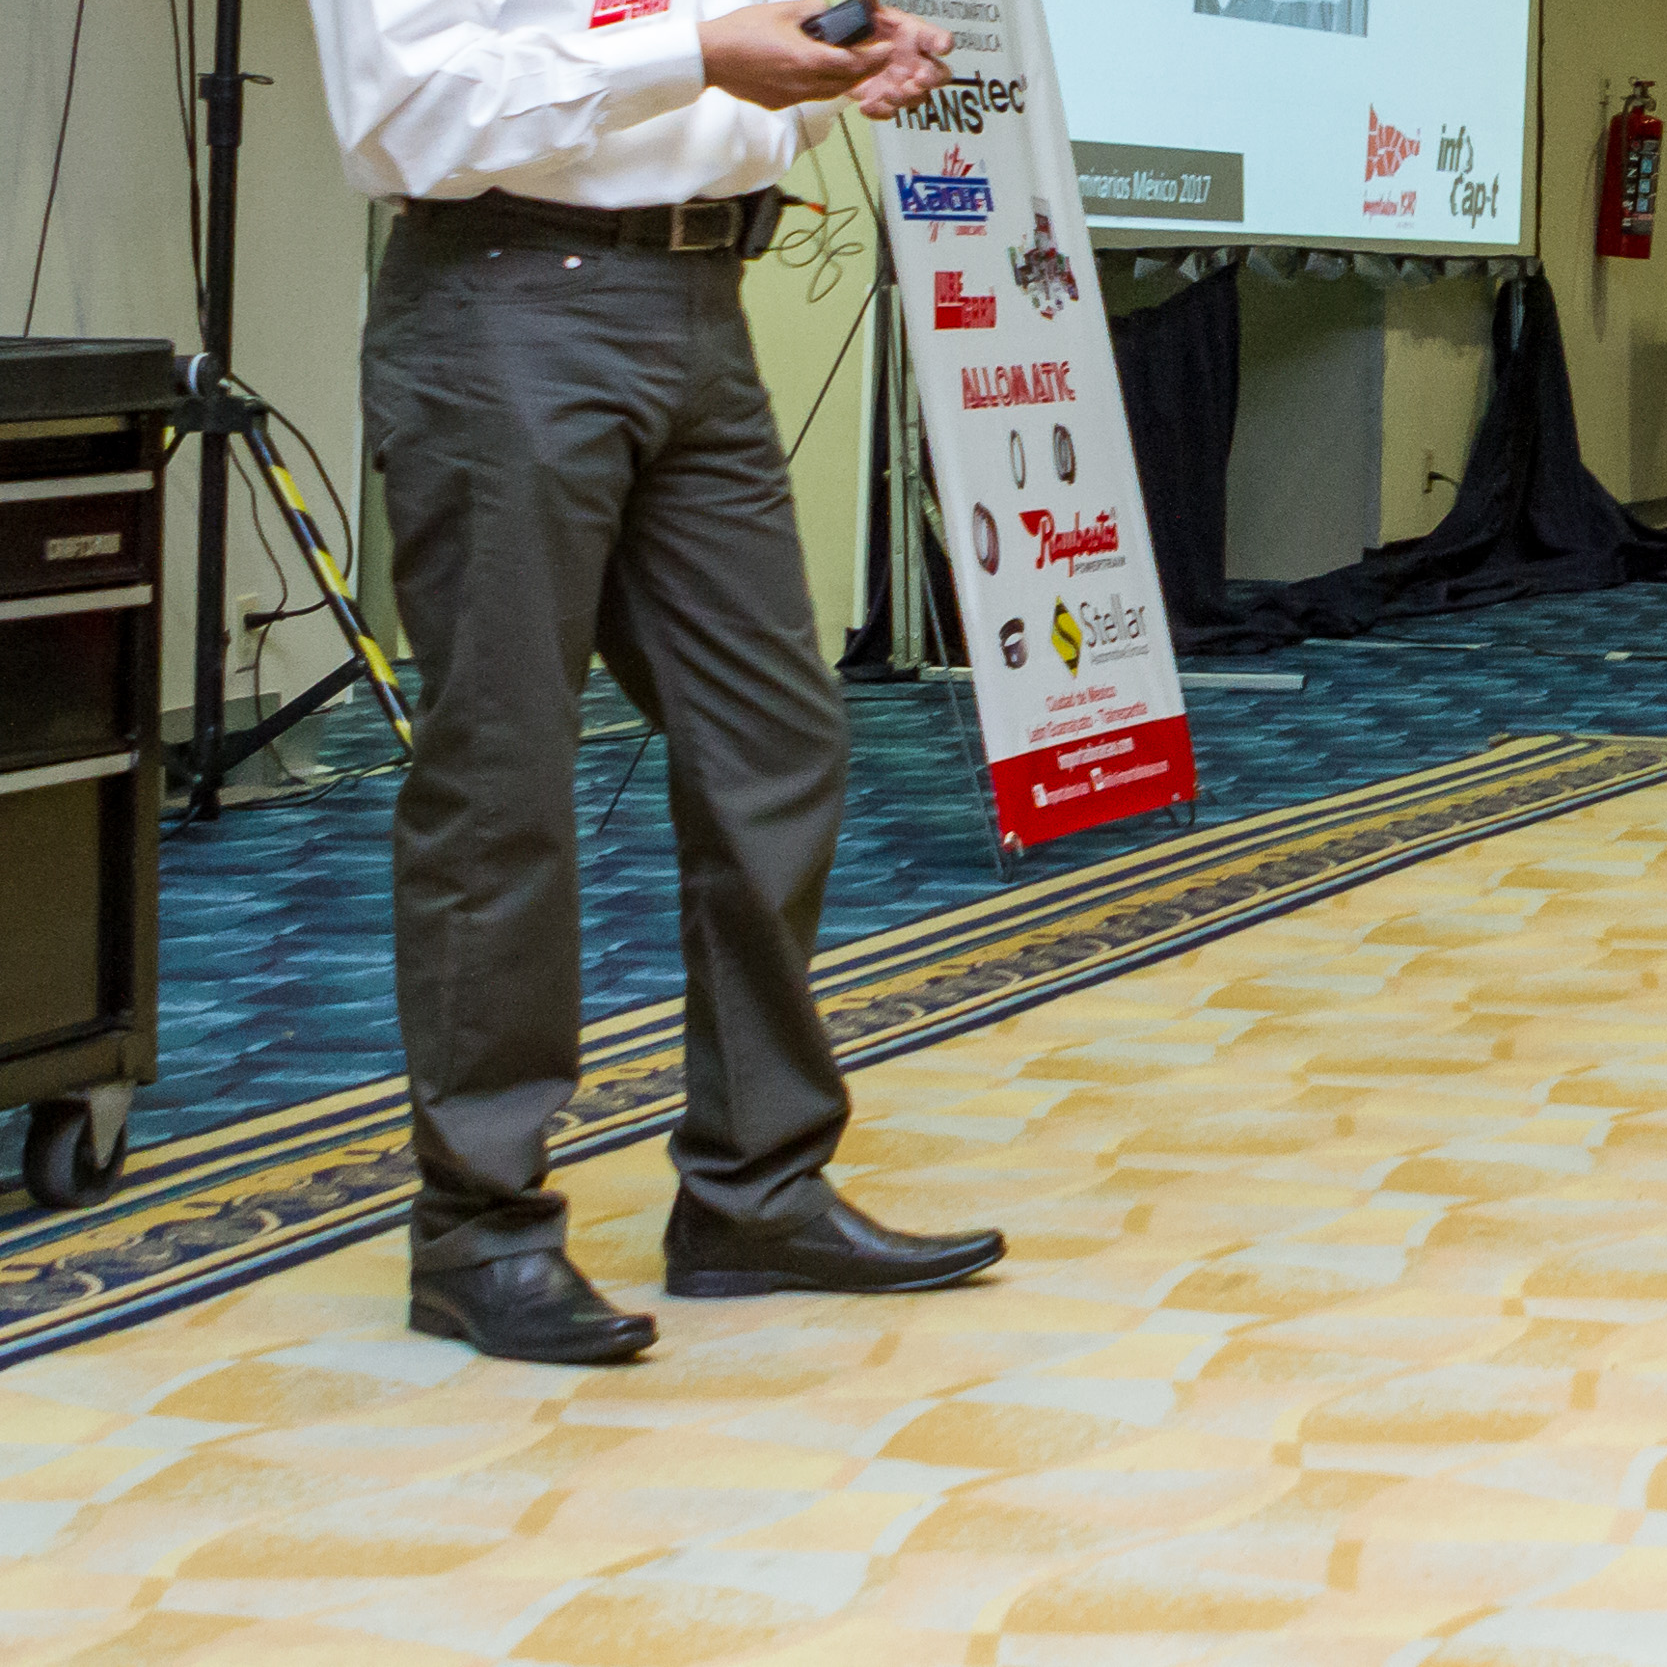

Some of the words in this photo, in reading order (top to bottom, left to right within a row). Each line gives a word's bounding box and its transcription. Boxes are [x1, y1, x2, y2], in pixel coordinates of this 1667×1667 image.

[1077, 165, 1131, 200] minarios
[1132, 168, 1178, 203] México
[1179, 172, 1212, 205] 2017
[961, 359, 1078, 411] ALLOMATIC
[1079, 593, 1146, 649] Stellar
